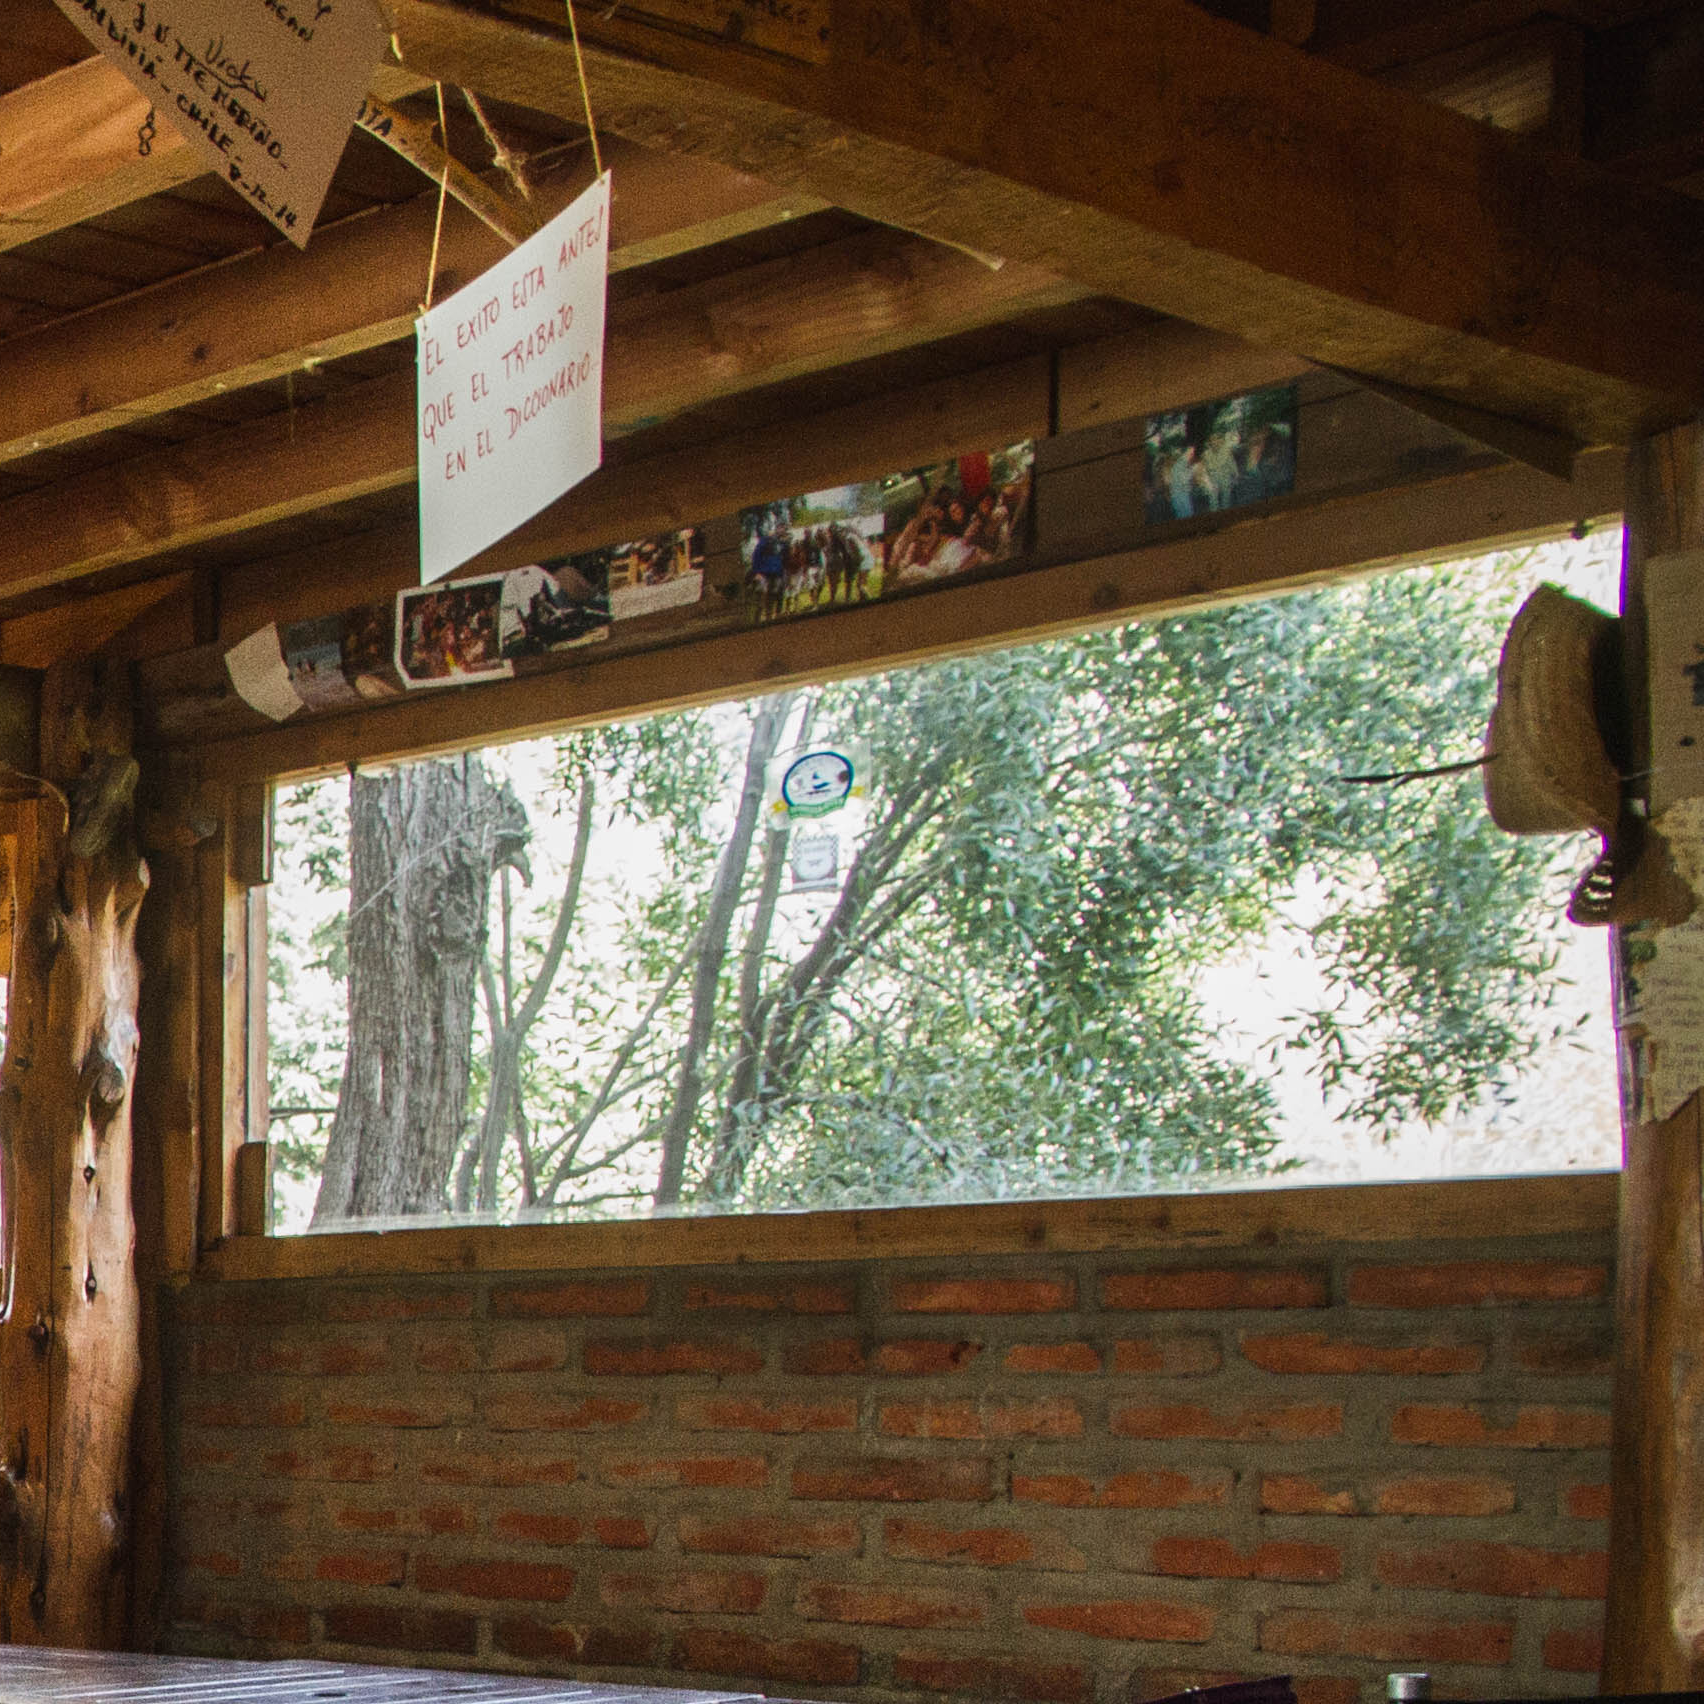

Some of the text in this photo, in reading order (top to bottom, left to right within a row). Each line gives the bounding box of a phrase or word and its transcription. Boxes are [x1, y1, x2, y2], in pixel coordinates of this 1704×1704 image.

[422, 304, 574, 444] QUE EL TRABAJO
[445, 447, 466, 481] EN
[477, 429, 494, 459] EL
